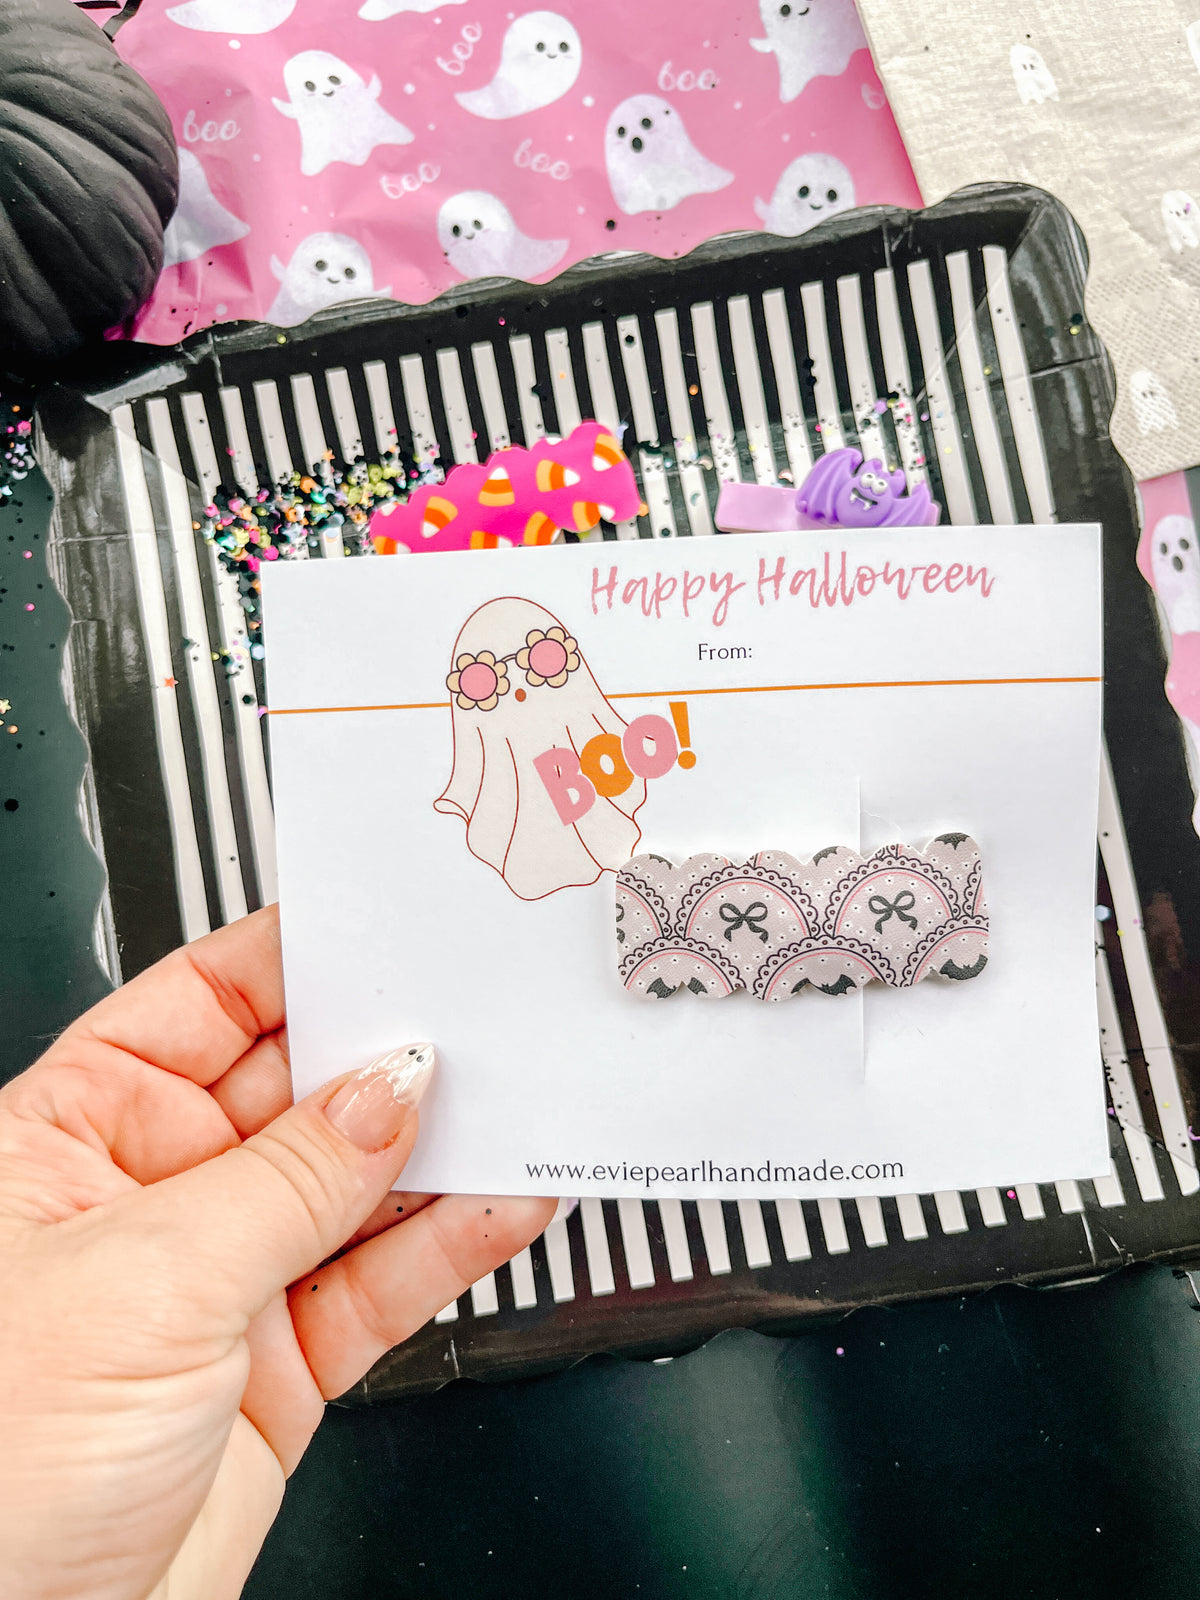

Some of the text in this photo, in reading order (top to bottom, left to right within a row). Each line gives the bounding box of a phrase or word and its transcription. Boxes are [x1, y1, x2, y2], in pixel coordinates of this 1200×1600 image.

[435, 21, 482, 76] boo
[657, 60, 719, 92] boo
[183, 109, 241, 143] boo
[513, 138, 572, 181] boo
[380, 162, 441, 200] boo
[591, 551, 995, 627] Happy Halloween
[697, 643, 753, 661] From:
[533, 701, 697, 826] BOO!
[525, 1159, 904, 1187] www.eviepearlhandmade.com
